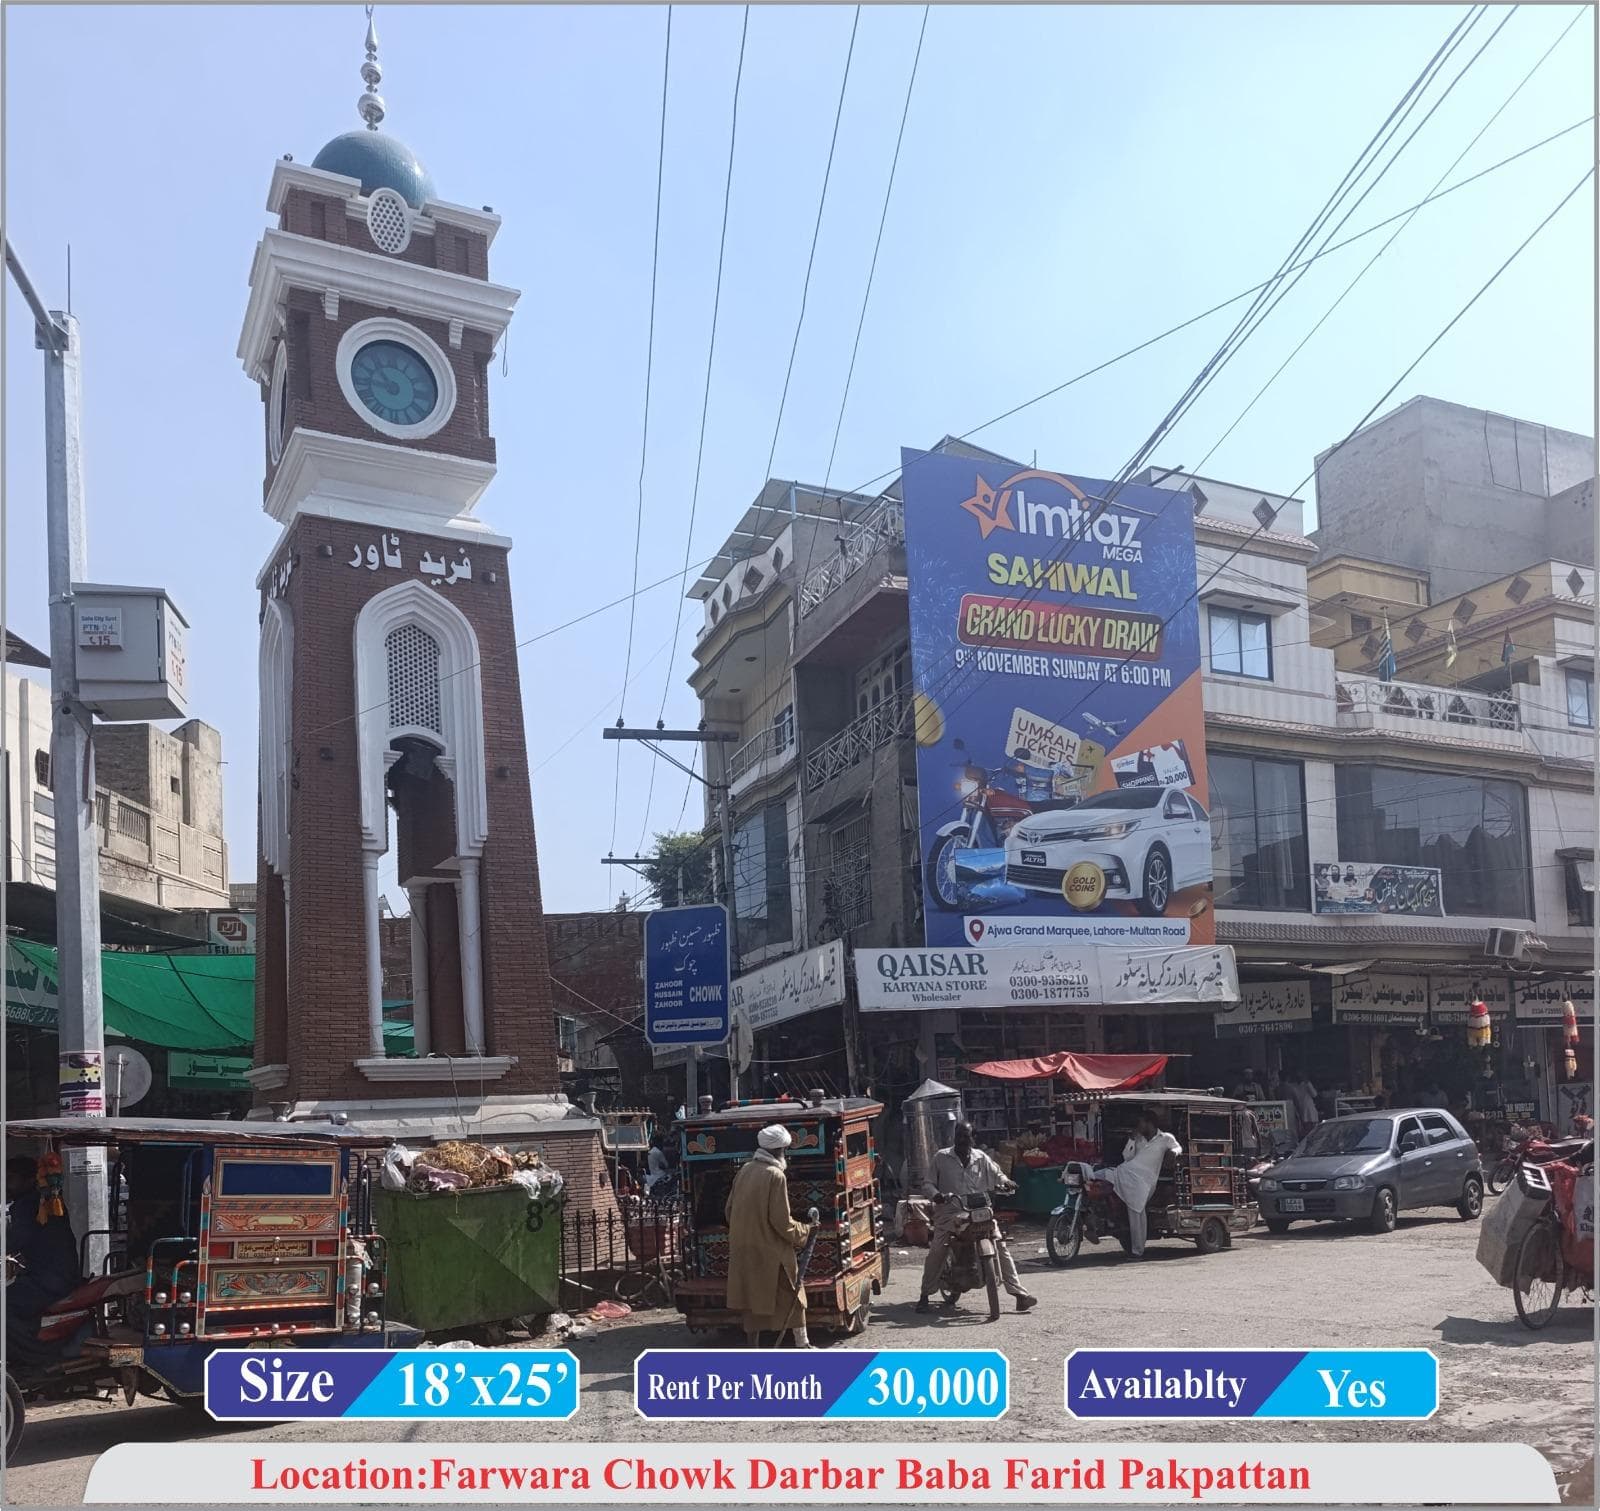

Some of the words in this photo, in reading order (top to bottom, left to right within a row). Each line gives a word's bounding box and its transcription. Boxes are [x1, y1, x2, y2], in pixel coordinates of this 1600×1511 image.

[1016, 490, 1142, 549] Imtiaz
[347, 532, 402, 571] ٹاور
[1102, 545, 1143, 563] MEGA
[418, 546, 472, 585] فرید
[986, 552, 1138, 600] SAHIWAL
[965, 603, 1036, 641] GRAND
[1037, 610, 1101, 648] LUCKY
[1102, 618, 1162, 653] DRAW
[977, 650, 1050, 677] NOVEMBER
[1052, 658, 1101, 682] SUNDAY
[1104, 663, 1119, 683] AT
[1121, 666, 1150, 686] 6:00
[1152, 668, 1172, 688] PM
[1017, 716, 1077, 751] UMRAH
[1014, 731, 1075, 767] TICKETS
[1068, 884, 1096, 893] COINS
[1072, 876, 1096, 885] GOLD
[660, 930, 679, 952] ظہور
[678, 925, 702, 948] حسین
[702, 922, 722, 945] ظہور
[987, 925, 1013, 938] Ajwa
[1013, 925, 1045, 936] Grand
[1046, 926, 1093, 939] Marquee,
[1093, 926, 1162, 937] Lahore-Multan
[1163, 926, 1187, 936] Road
[673, 952, 698, 975] چوک
[877, 952, 989, 981] QAISAR
[1115, 953, 1142, 988] سٹور
[1199, 953, 1223, 992] قیصر
[655, 980, 683, 989] ZAHOOR
[883, 981, 943, 993] KARYANA
[945, 980, 988, 991] STORE
[1009, 974, 1089, 987] 0300-9358210
[654, 990, 683, 999] HUSSAIN
[654, 1000, 683, 1009] ZAHOOR
[689, 985, 722, 1002] CHOWK
[912, 993, 962, 1002] Wholesaler
[1011, 987, 1090, 1000] 0300-1877755
